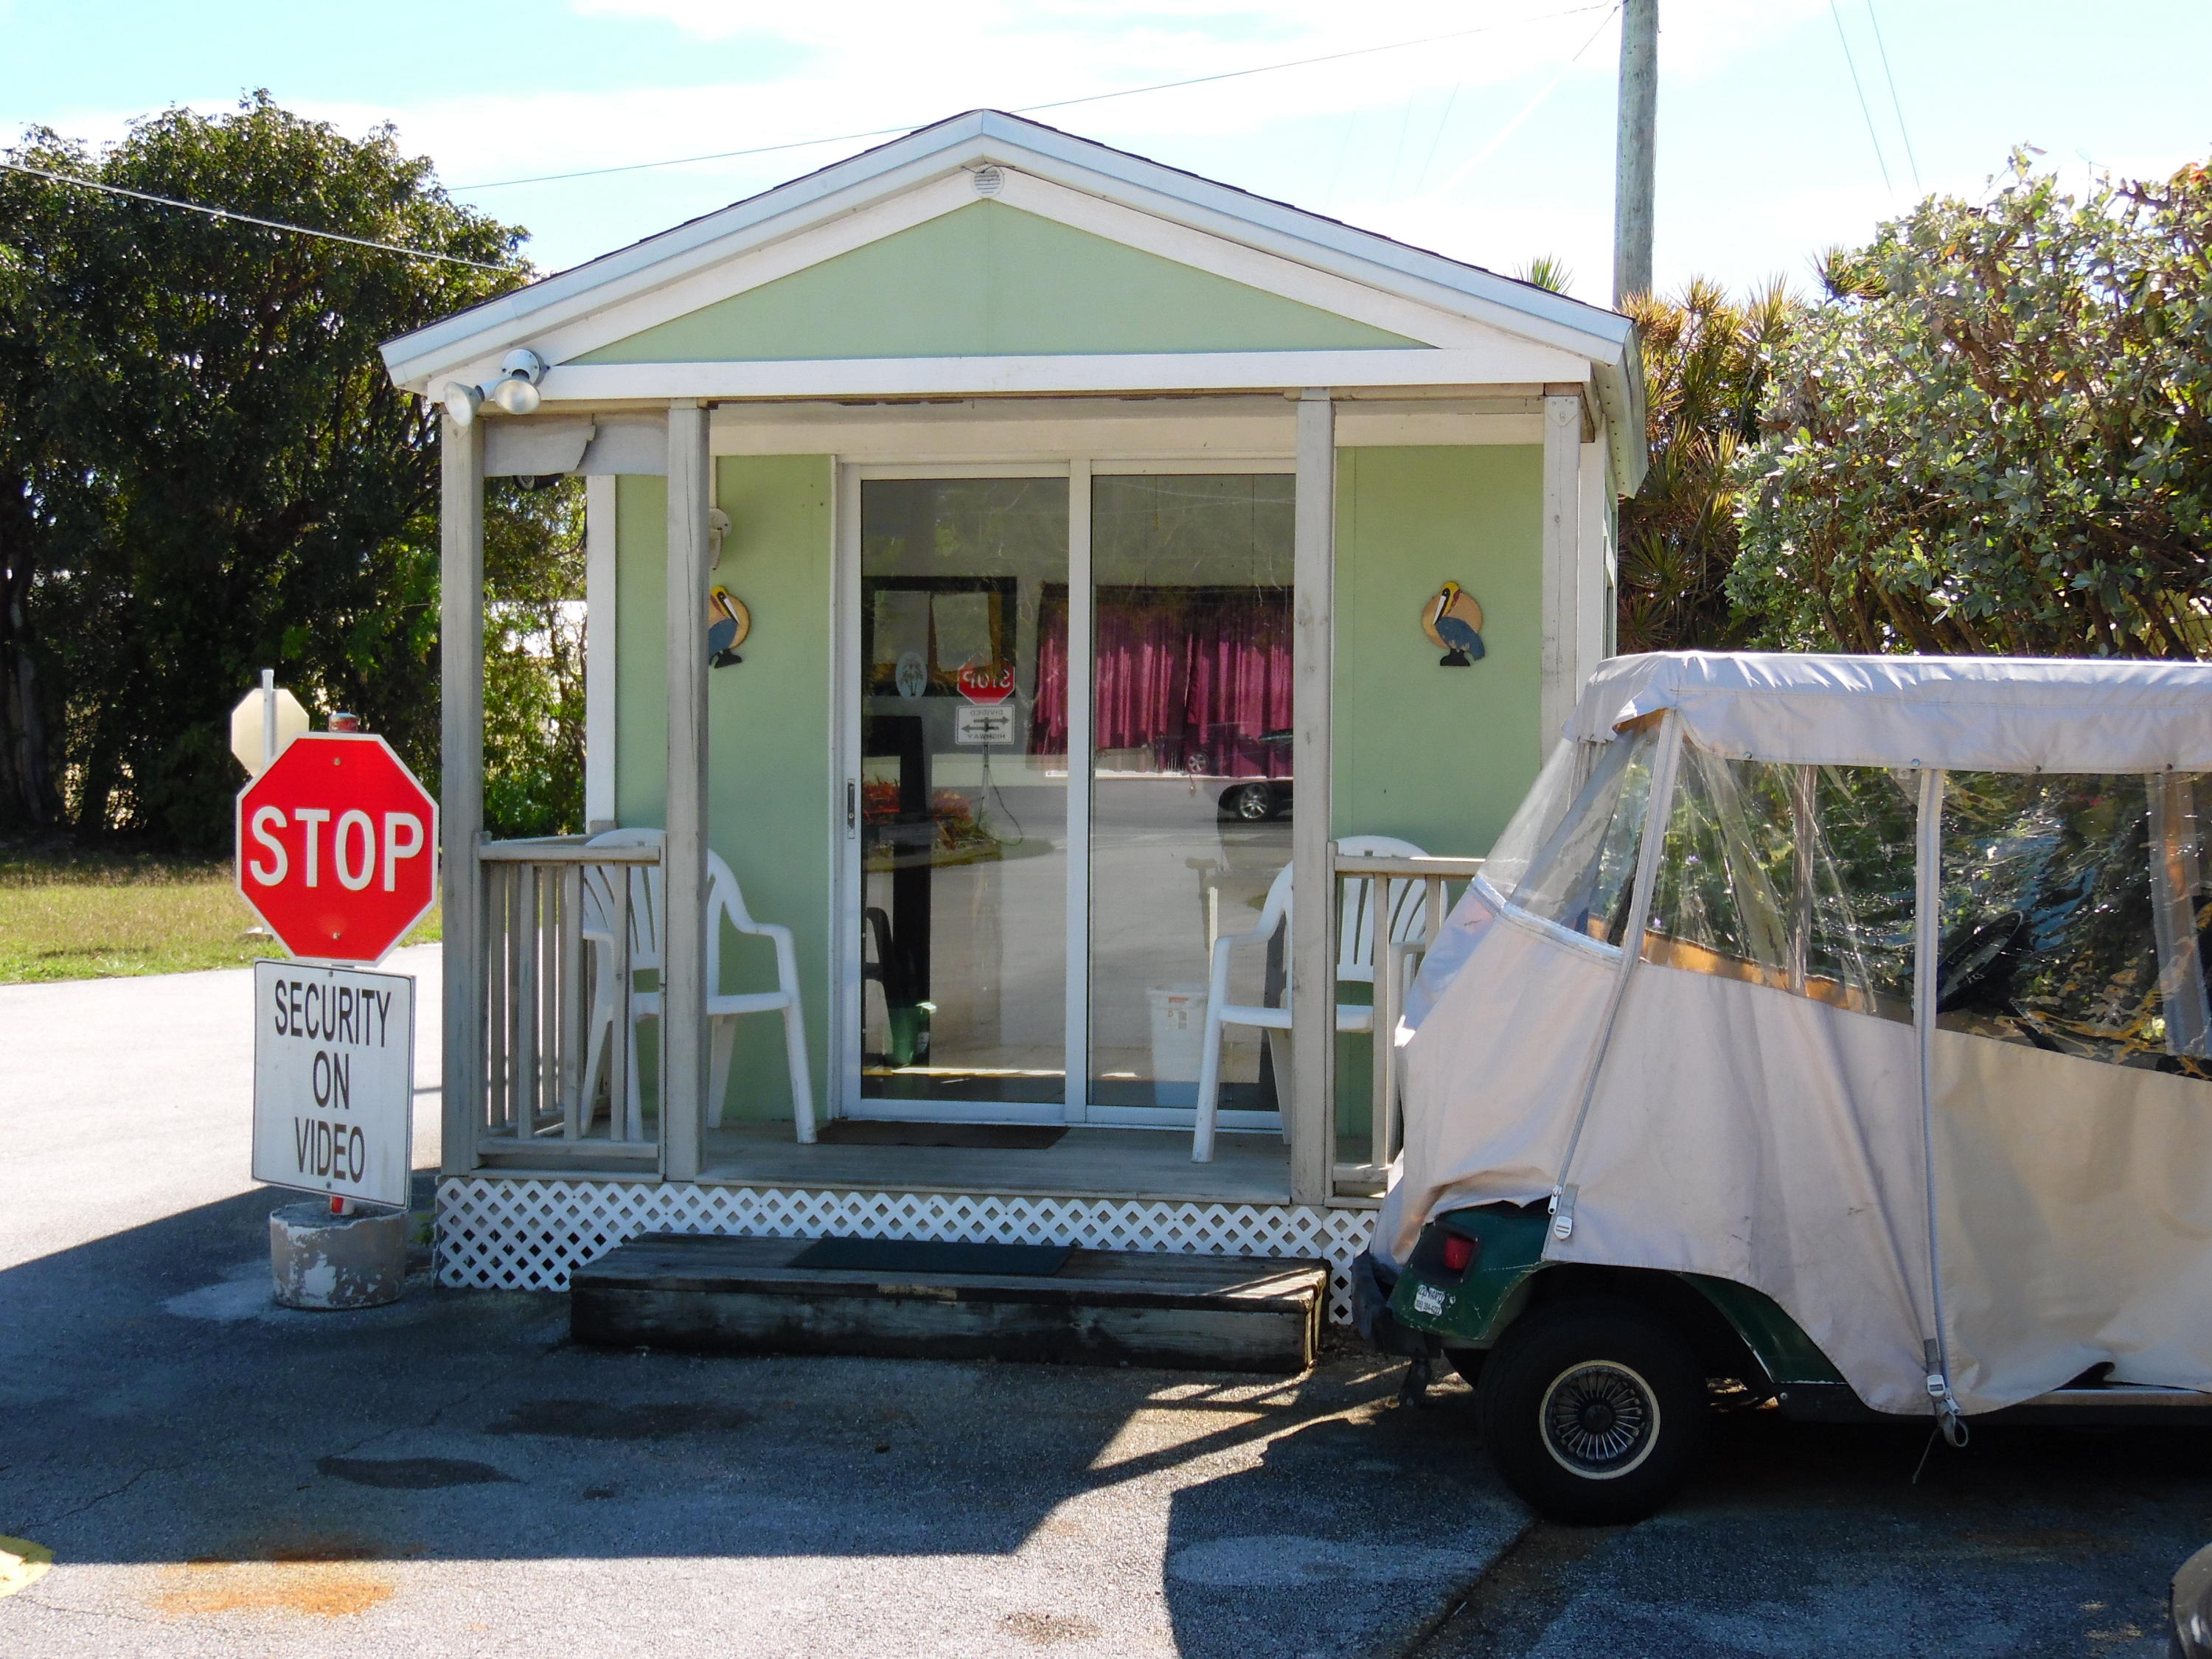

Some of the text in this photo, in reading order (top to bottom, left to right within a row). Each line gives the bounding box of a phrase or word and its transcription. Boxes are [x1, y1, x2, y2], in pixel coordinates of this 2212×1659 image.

[250, 806, 424, 891] STOP
[275, 979, 392, 1048] SECURITY
[313, 1050, 349, 1109] ON
[295, 1116, 365, 1183] VIDEO
